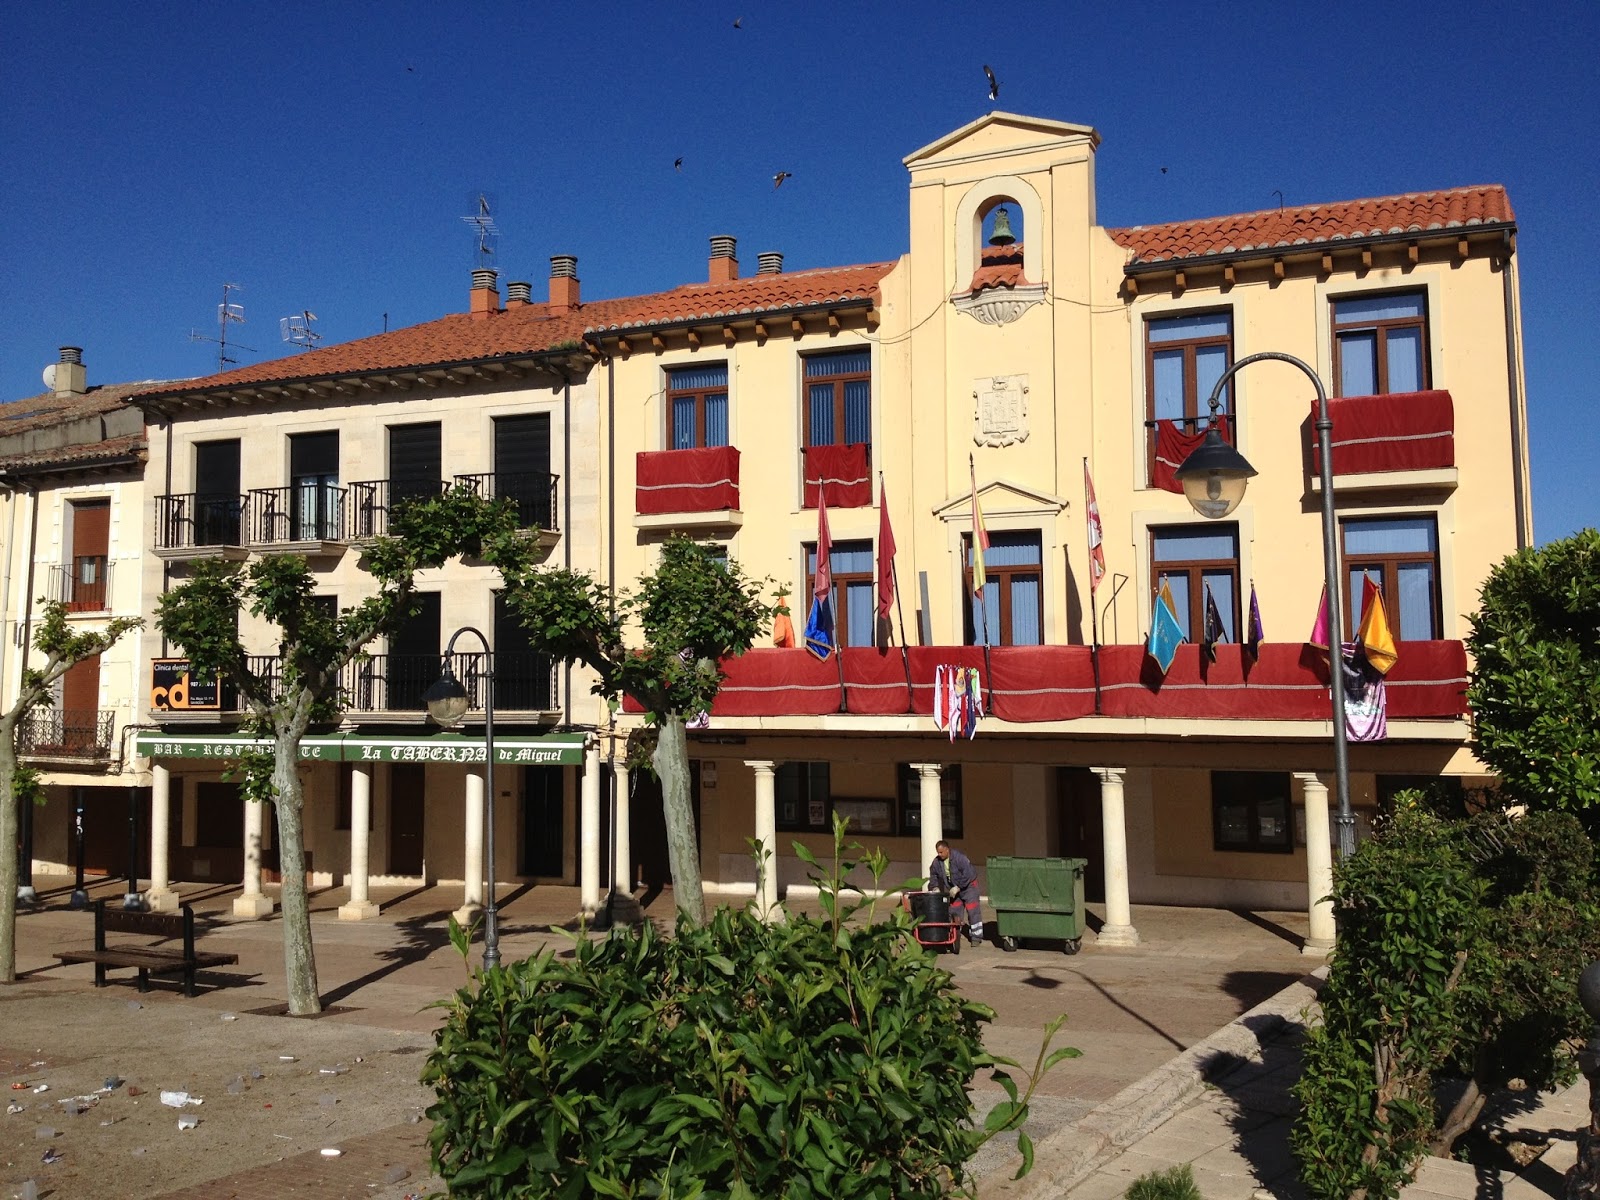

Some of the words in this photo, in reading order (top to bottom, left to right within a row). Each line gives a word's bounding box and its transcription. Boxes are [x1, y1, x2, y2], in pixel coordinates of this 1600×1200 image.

[153, 743, 183, 756] BAR
[361, 745, 382, 760] La
[390, 746, 487, 762] TABERNA
[499, 748, 513, 760] de
[514, 748, 563, 763] Miguel
